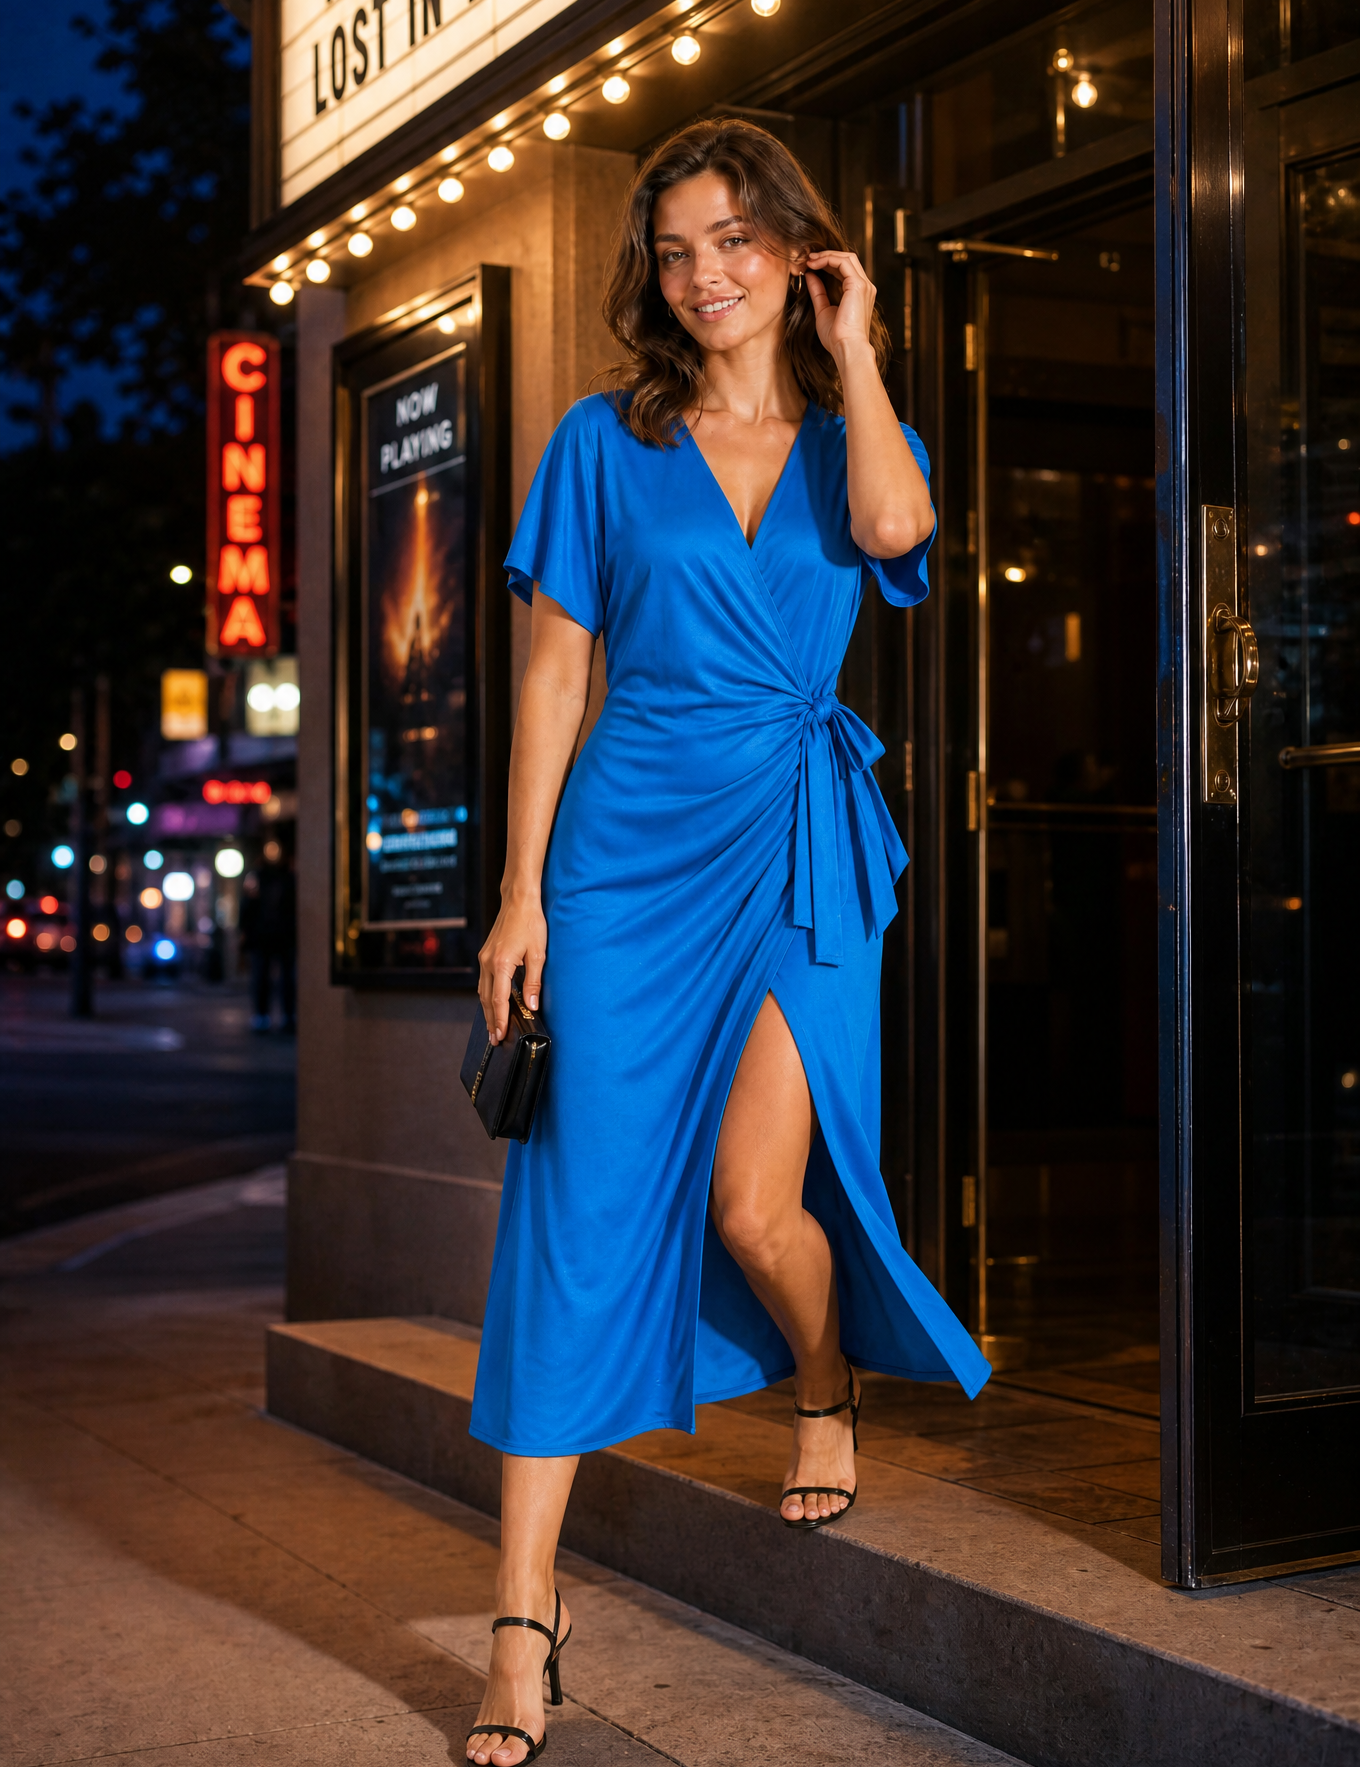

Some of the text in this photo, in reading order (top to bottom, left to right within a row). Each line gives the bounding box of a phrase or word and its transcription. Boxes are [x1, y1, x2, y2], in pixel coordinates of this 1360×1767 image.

[314, 0, 388, 116] LOST
[380, 418, 453, 475] PLAYING
[395, 381, 439, 428] NOW
[217, 341, 271, 648] CINEMA
